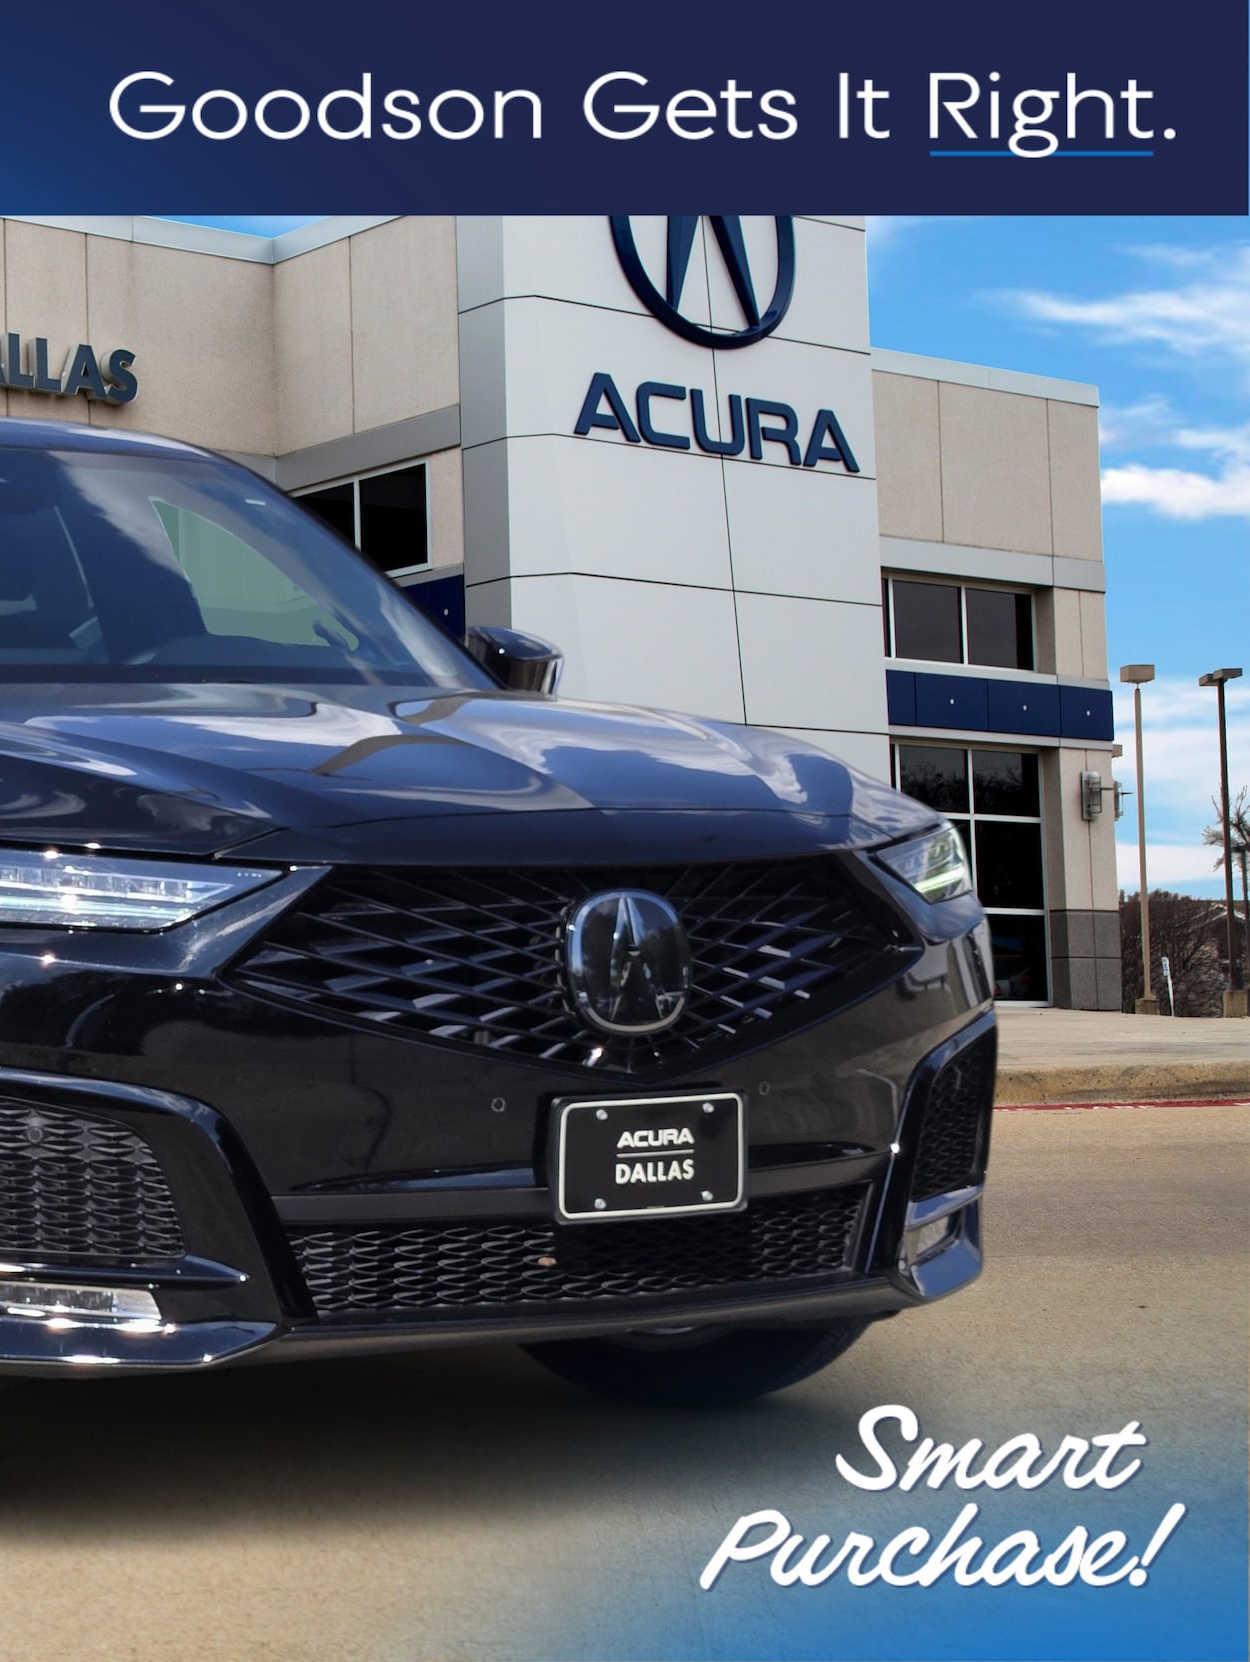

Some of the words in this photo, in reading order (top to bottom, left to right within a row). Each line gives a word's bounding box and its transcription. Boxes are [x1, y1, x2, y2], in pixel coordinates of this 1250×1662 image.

[573, 371, 860, 473] ACURA
[616, 1127, 695, 1149] ACURA
[615, 1158, 695, 1184] DALLAS
